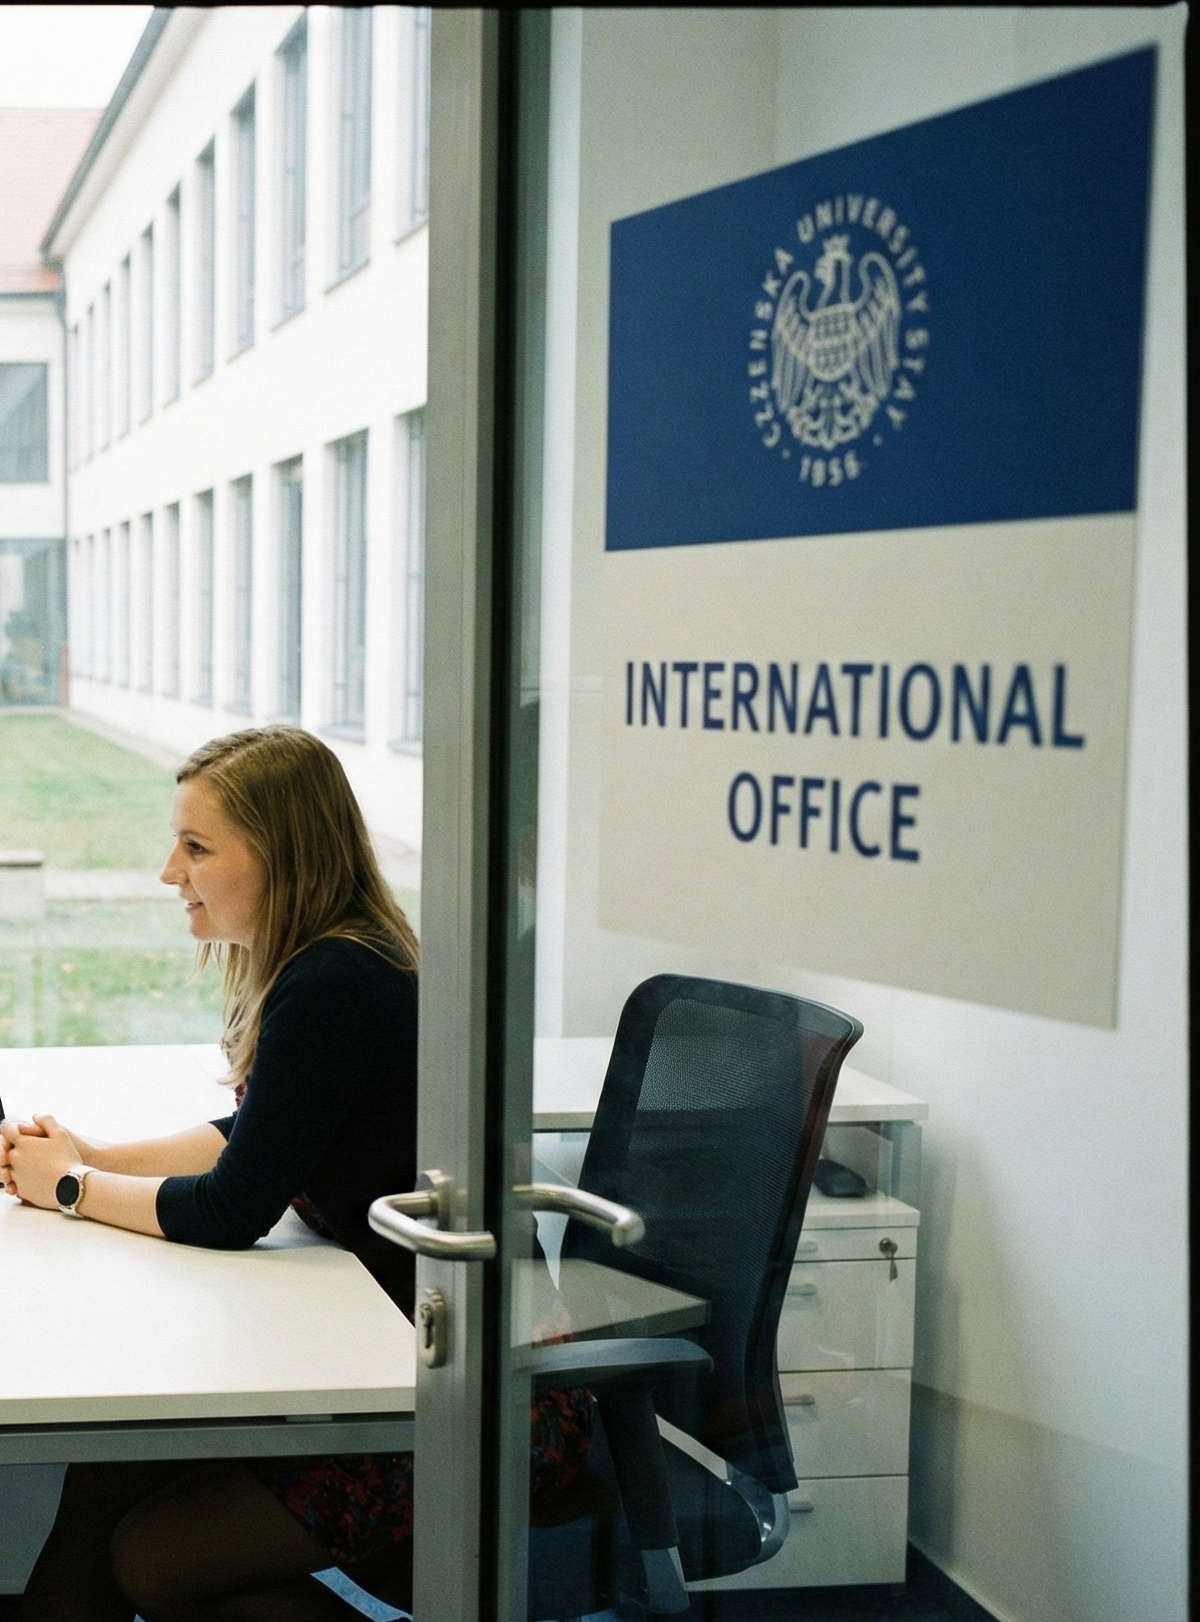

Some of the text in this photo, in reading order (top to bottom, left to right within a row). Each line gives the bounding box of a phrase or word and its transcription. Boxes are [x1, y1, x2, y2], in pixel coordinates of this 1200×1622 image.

[797, 195, 930, 313] UNIVERSITY
[625, 660, 1086, 750] INTERNATIONAL
[726, 771, 921, 864] OFFICE
